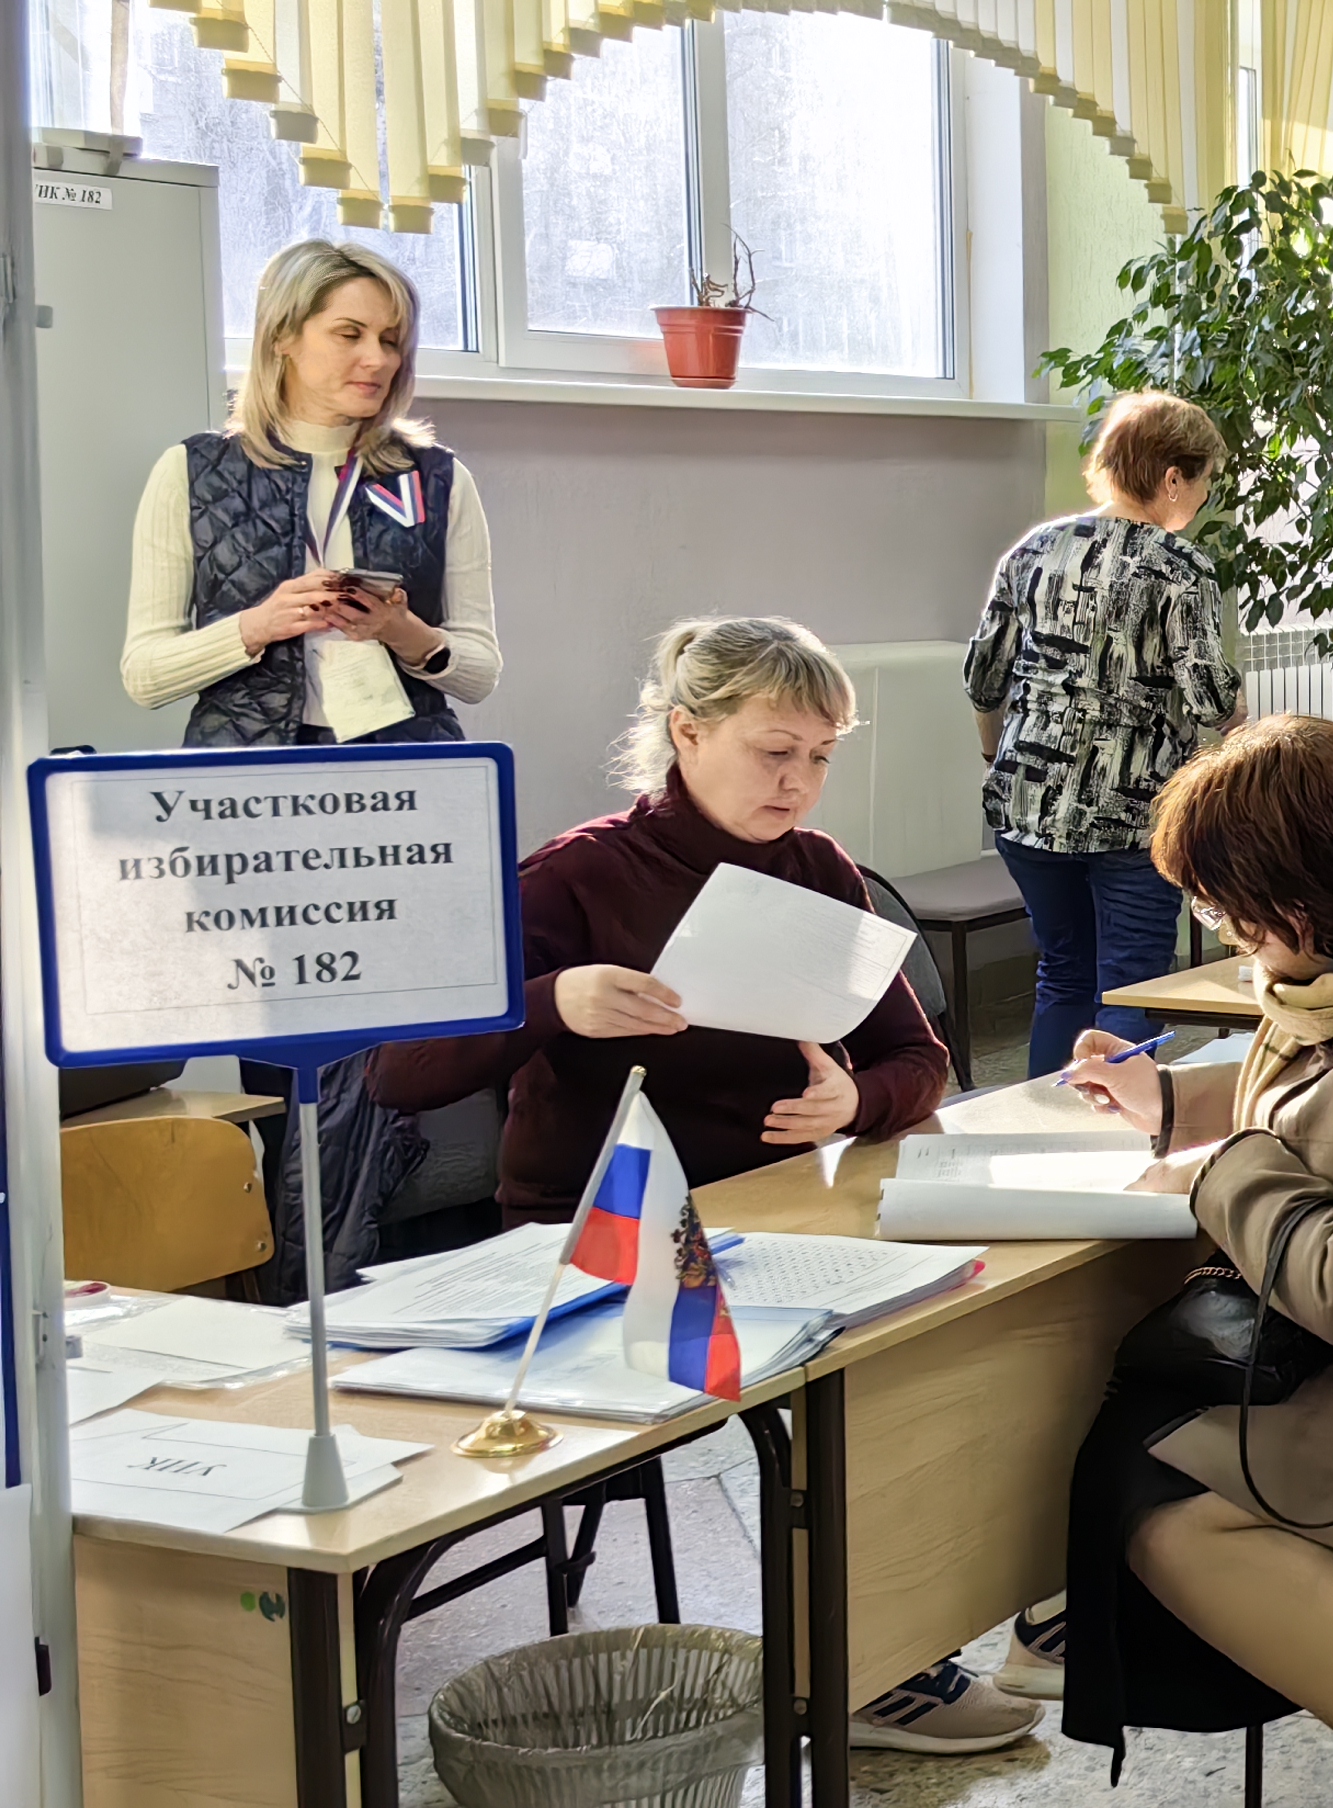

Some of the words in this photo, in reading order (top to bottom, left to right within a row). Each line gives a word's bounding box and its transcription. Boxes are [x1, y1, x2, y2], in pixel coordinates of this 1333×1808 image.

[35, 184, 60, 200] ИК
[62, 187, 77, 202] №
[79, 189, 102, 204] 182
[150, 788, 419, 823] Участковая
[118, 841, 455, 886] избирательная
[185, 898, 399, 934] комиссия
[226, 956, 277, 991] №
[292, 950, 363, 985] 182
